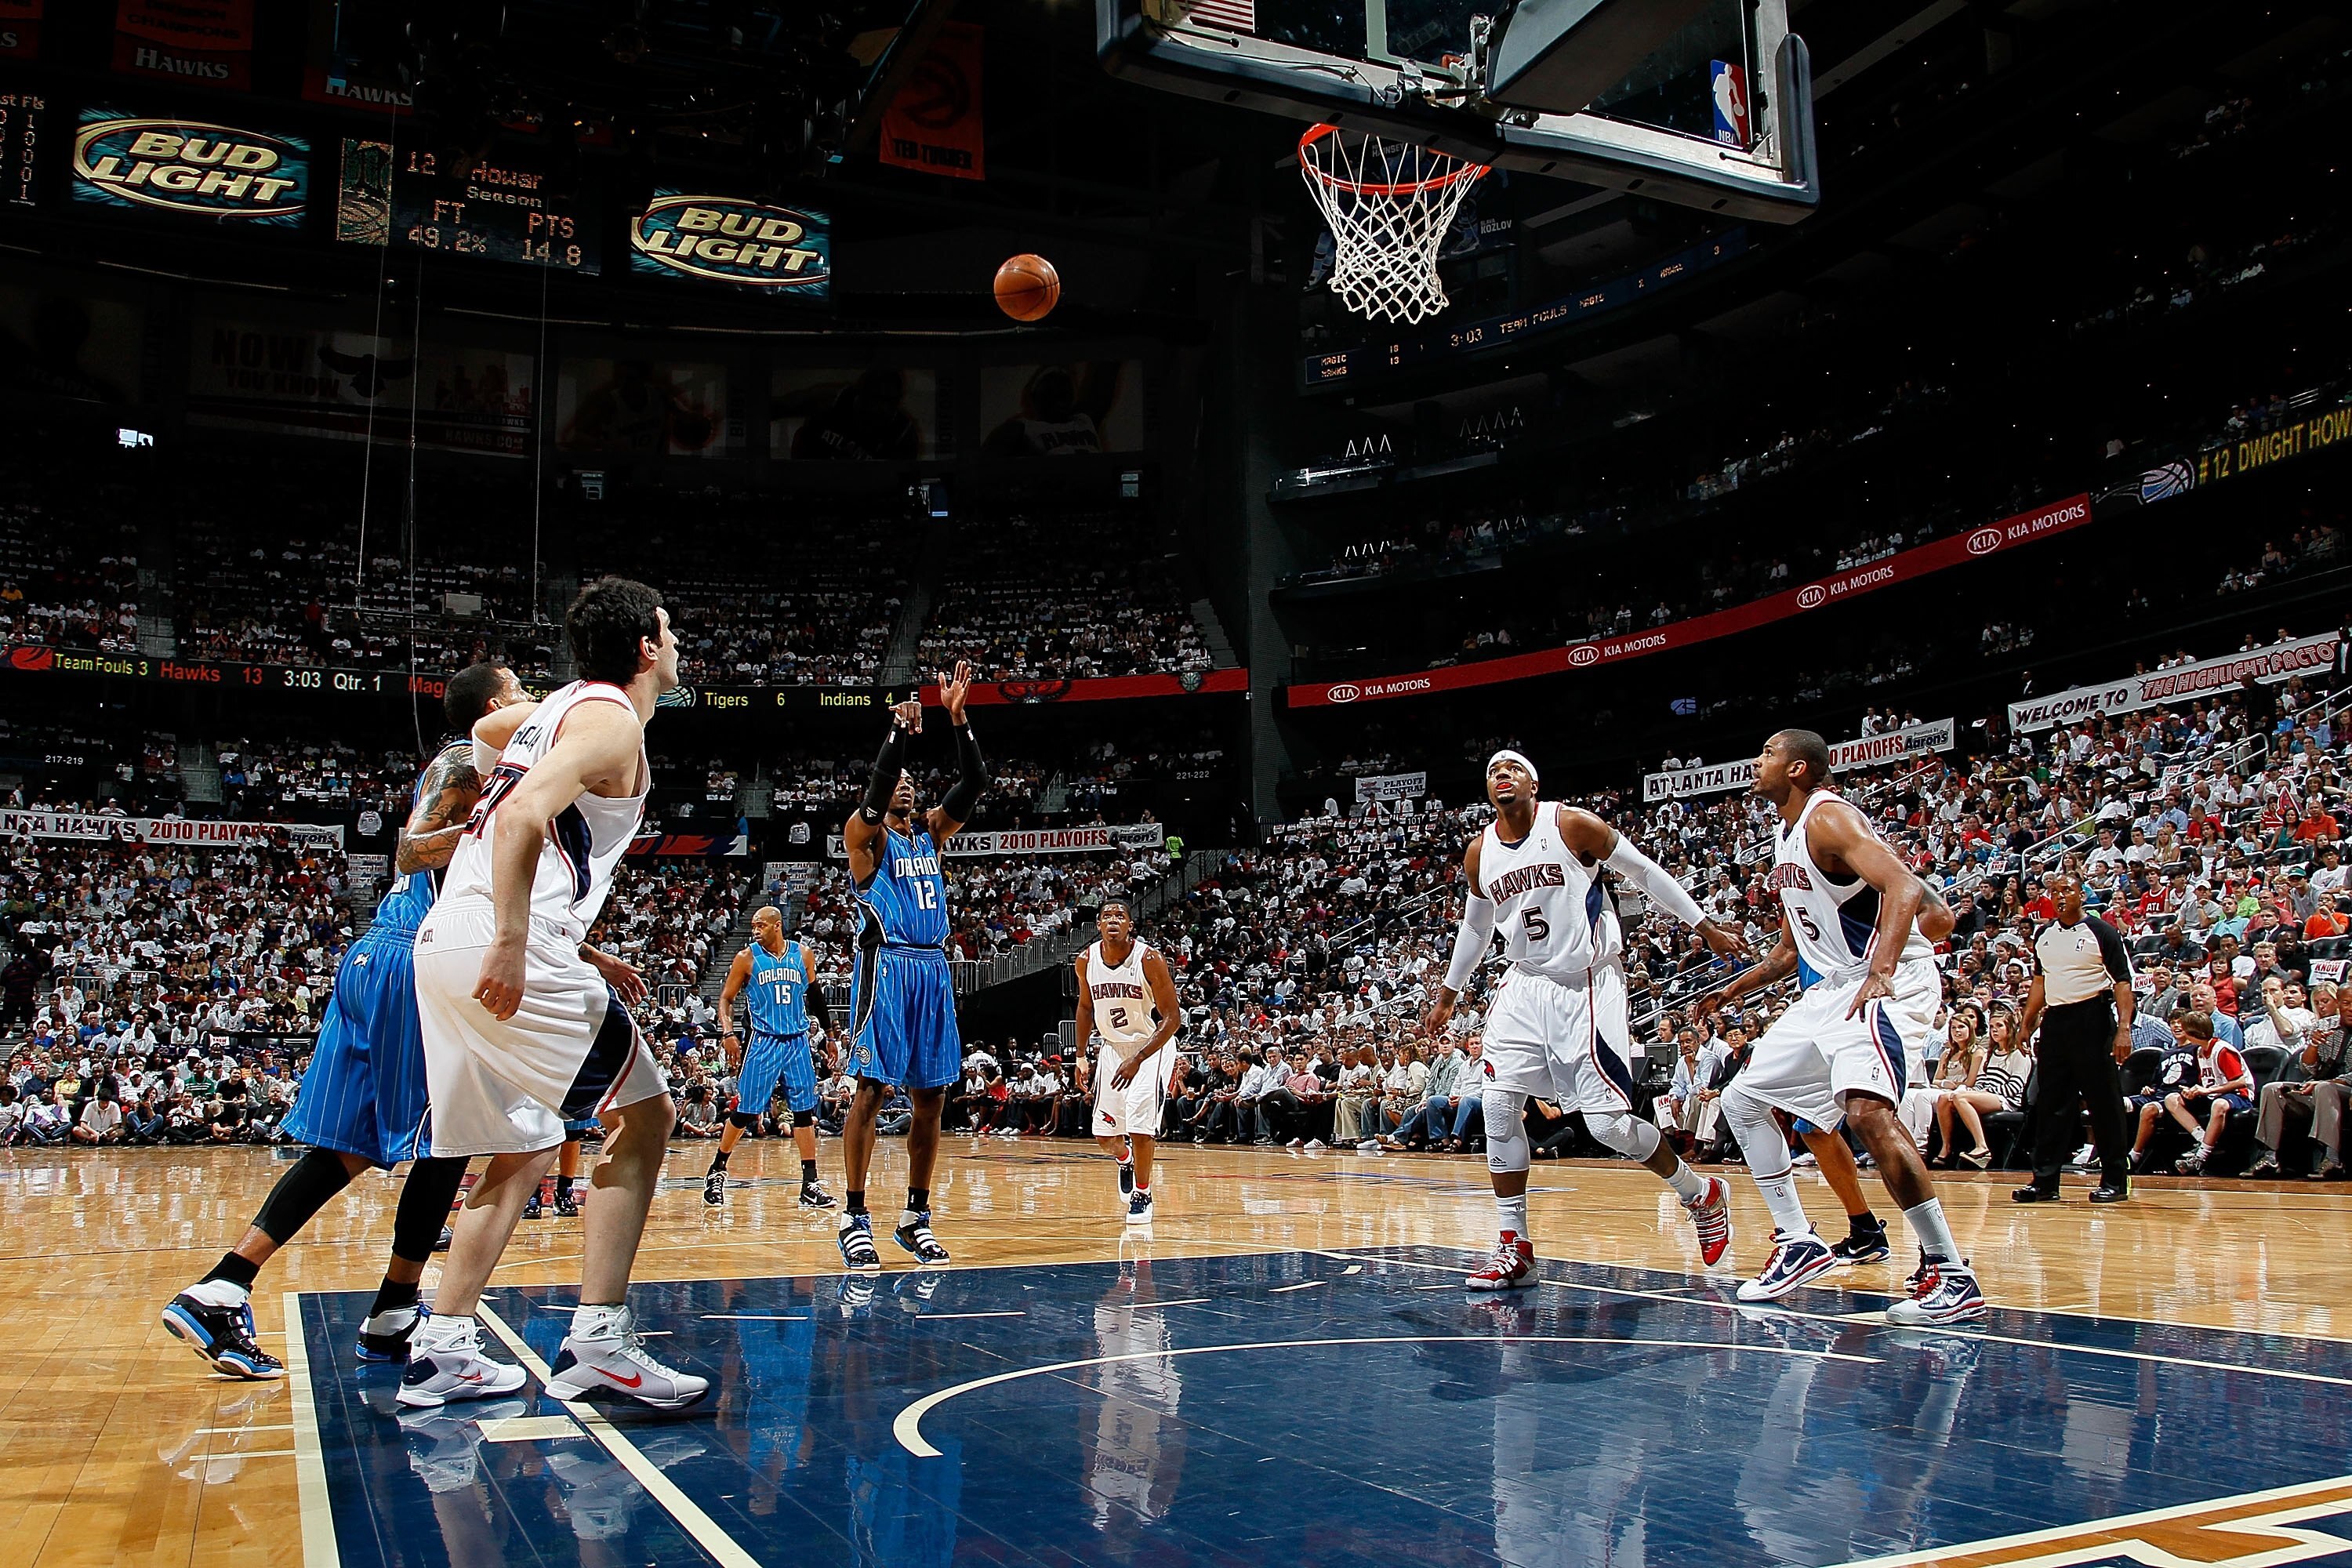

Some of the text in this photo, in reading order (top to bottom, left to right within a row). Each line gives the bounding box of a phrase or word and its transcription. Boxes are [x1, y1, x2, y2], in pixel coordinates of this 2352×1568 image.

[135, 47, 230, 79] HAWKS
[325, 75, 413, 106] HAWKS
[1718, 129, 1738, 144] NBA
[128, 131, 278, 169] BUD
[407, 151, 436, 175] 12
[90, 156, 296, 201] LIGHT
[466, 185, 543, 208] Season
[433, 199, 575, 238] FT PTS
[677, 207, 803, 242] BUD
[1480, 220, 1512, 234] KOZLOV
[408, 225, 582, 267] 49.2% 14.8
[644, 230, 818, 271] LIGHT
[1499, 317, 1527, 334] TEAM
[1450, 328, 1483, 347] 3:03
[1320, 354, 1347, 366] MAGIC
[2238, 423, 2306, 472] DWIGHT
[2309, 406, 2352, 449] HOW
[1972, 503, 2086, 551] KIA KIA MOTORS
[1802, 564, 1895, 605] KIA KIA MOTORS
[1573, 633, 1667, 663] KIA KIA MOTORS
[55, 653, 148, 676] Team Fouls 3
[160, 662, 263, 684] Hawks 13
[283, 670, 321, 688] 3:03
[333, 673, 381, 691] Qtr. 1
[408, 676, 445, 699] Mag
[1333, 678, 1431, 699] KIA KIA MOTORS
[2016, 640, 2338, 727] WELCOME TO THE HIGHLIGHT FACTO
[526, 685, 551, 699] Tea
[704, 691, 785, 709] Tigers 6
[820, 692, 893, 706] Indians 4
[1842, 735, 1904, 766] PLAYOFFS
[1904, 731, 1949, 752] Aaron's
[45, 755, 84, 765] 217-219
[1176, 771, 1210, 780] 221-222
[1383, 777, 1425, 788] PLAYOFF
[1649, 764, 1754, 796] ATLANTA HA
[1382, 784, 1425, 796] CENTRAL
[0, 814, 47, 831] NTA
[55, 817, 136, 837] HAWKS
[149, 821, 194, 840] 2010
[942, 829, 1108, 851] AWKS 2010 PLAYOFFS
[895, 856, 939, 878] ORLAND
[913, 880, 937, 910] 12
[1488, 863, 1566, 907] HAWKS
[2146, 902, 2161, 912] ATL
[1520, 906, 1551, 942] 5
[757, 968, 801, 985] ORLANDO
[2315, 964, 2340, 972] KNOW
[774, 983, 792, 1004] 15
[1091, 983, 1144, 1000] HAWKS
[1109, 1007, 1129, 1029] 2
[2161, 1052, 2194, 1073] PACE
[1657, 1097, 1669, 1108] KN
